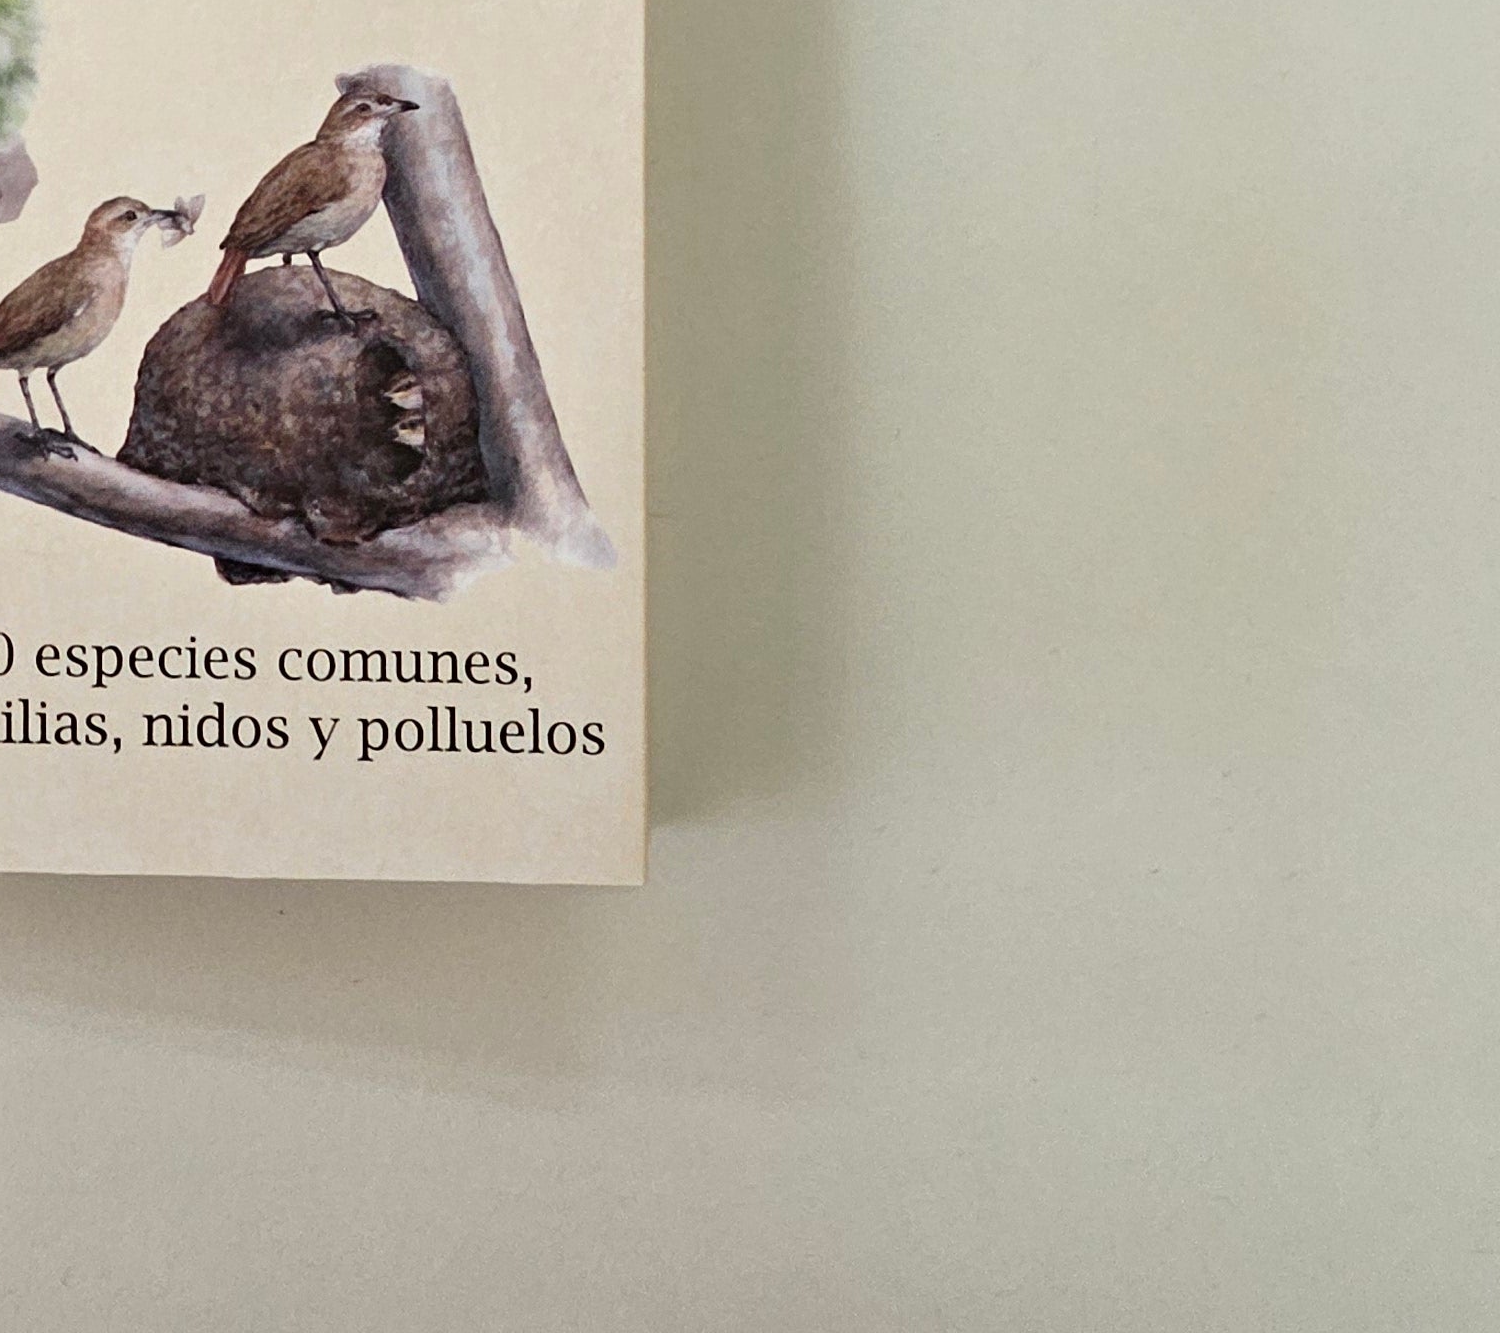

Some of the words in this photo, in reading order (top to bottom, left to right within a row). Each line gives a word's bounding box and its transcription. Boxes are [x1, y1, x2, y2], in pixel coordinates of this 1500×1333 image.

[34, 636, 257, 687] especies
[277, 642, 533, 692] comunes,
[141, 702, 290, 749] nidos
[310, 714, 338, 760] y
[357, 705, 606, 761] polluelos
